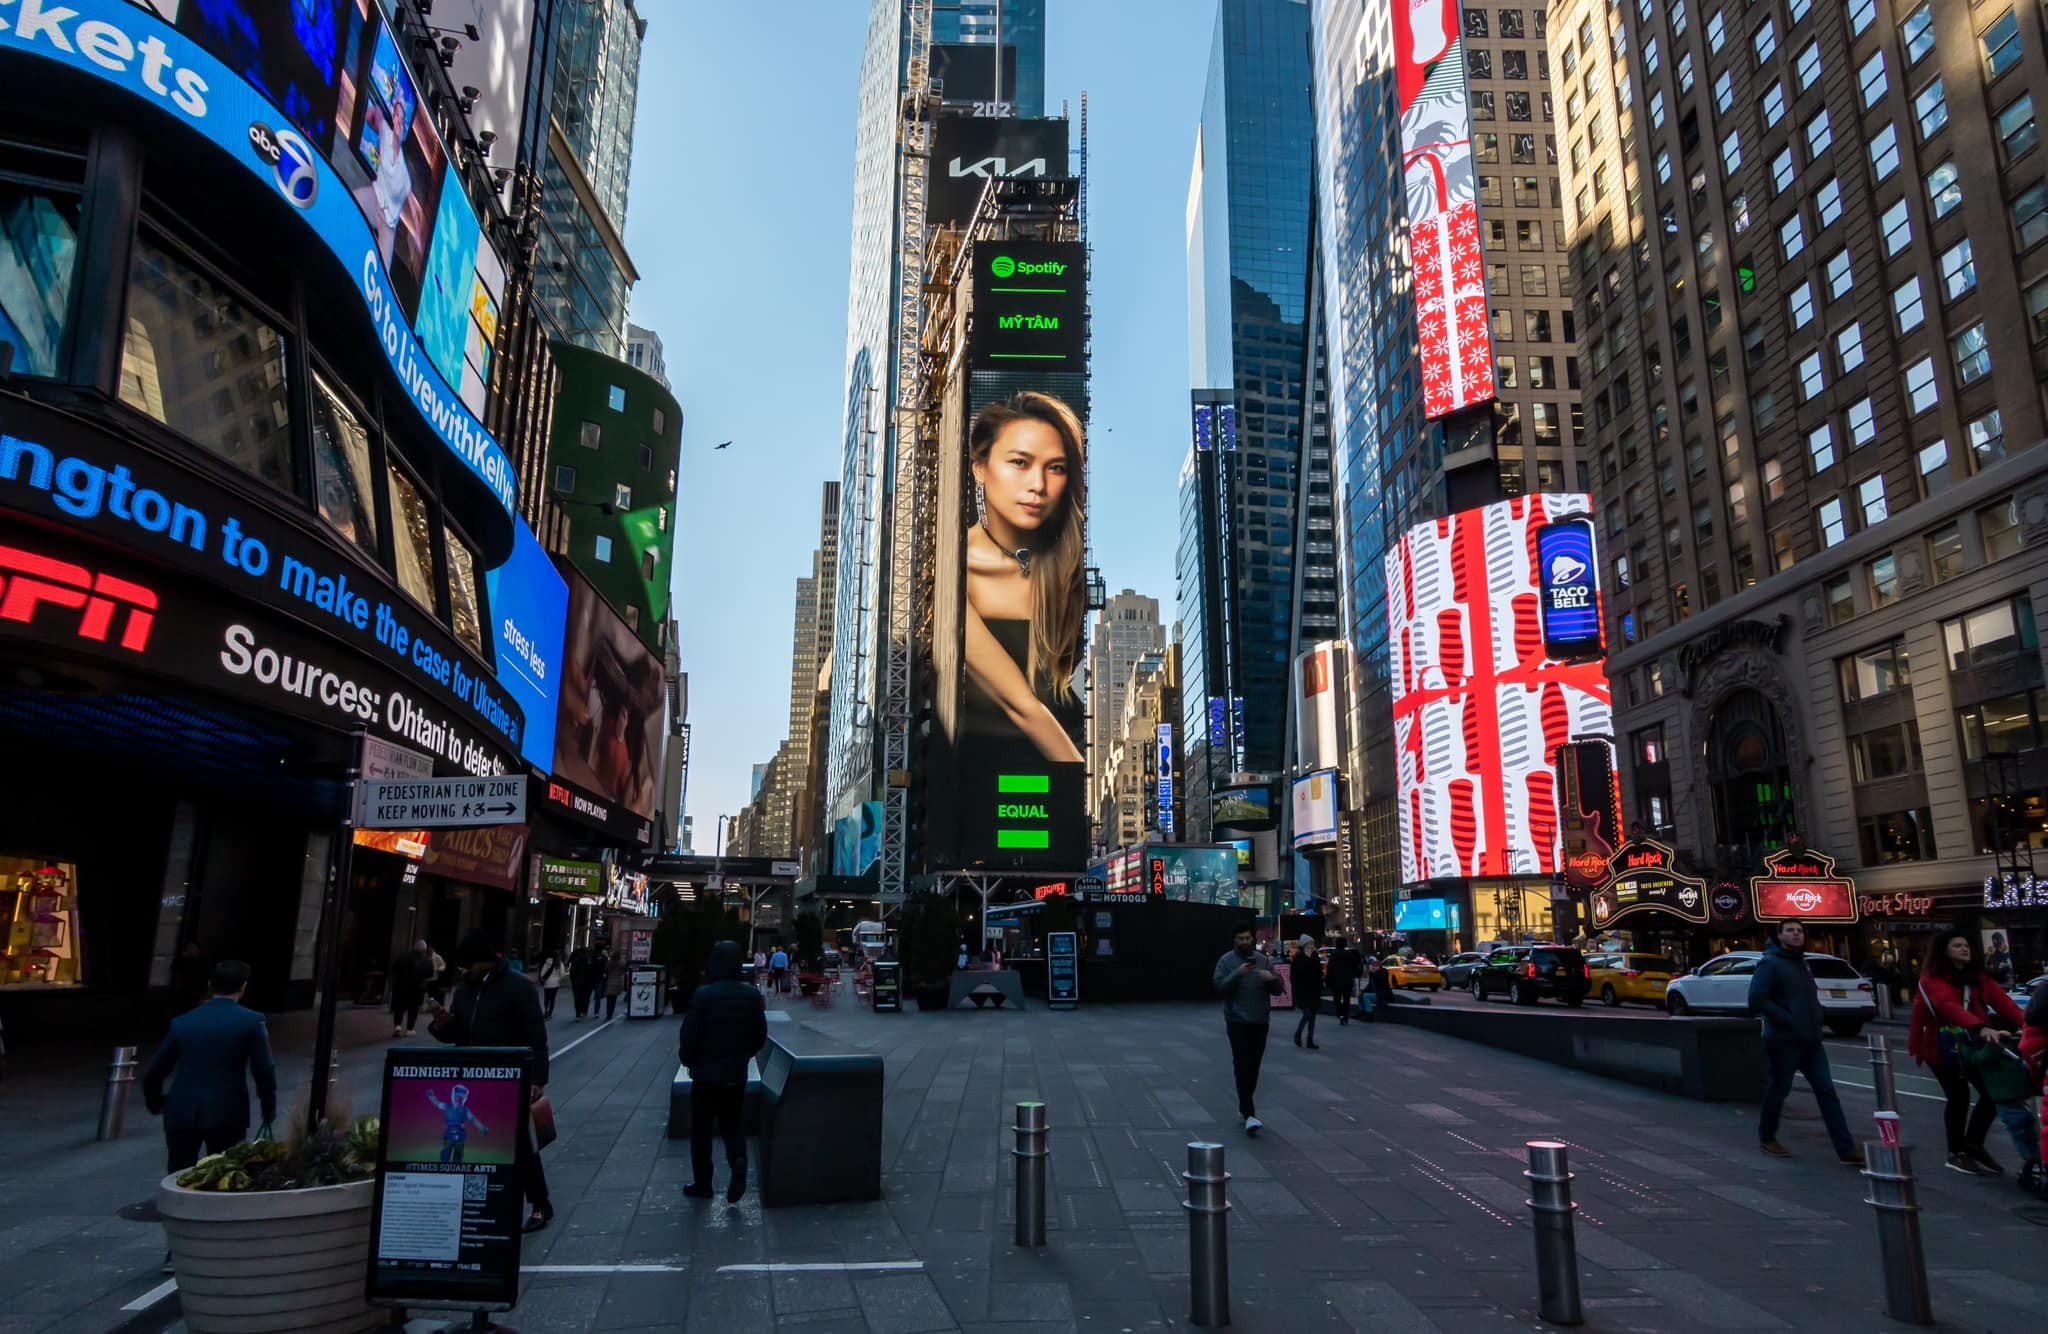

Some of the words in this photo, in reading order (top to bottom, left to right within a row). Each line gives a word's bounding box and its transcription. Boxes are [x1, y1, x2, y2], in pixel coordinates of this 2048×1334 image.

[0, 0, 208, 118] kets
[249, 127, 280, 160] abc
[1018, 262, 1067, 276] Spotify
[363, 250, 383, 323] Go
[383, 302, 398, 357] to
[1025, 315, 1058, 329] TÂM
[1550, 586, 1588, 598] TACO
[1553, 596, 1590, 609] BELL
[222, 517, 268, 577] to
[280, 555, 369, 630] make
[376, 601, 409, 655] the
[413, 638, 451, 685] case
[452, 660, 473, 702] for
[473, 677, 510, 737] Ukraine
[503, 618, 530, 662] stress
[529, 640, 546, 680] less
[220, 623, 382, 723] Sources:
[387, 691, 447, 755] Ohtani
[448, 727, 463, 764] to
[464, 739, 493, 777] defer
[379, 784, 452, 801] PEDESTRIAN
[455, 783, 486, 799] FLOW
[489, 782, 520, 797] ZONE
[548, 781, 571, 808] NETFLIX
[574, 796, 587, 812] NOW
[587, 802, 608, 822] PLAYING
[378, 805, 407, 820] KEEP
[412, 803, 456, 819] MOVING
[998, 804, 1049, 818] EQUAL
[1341, 819, 1353, 869] SQUARE
[1570, 858, 1589, 867] Hard
[1628, 853, 1645, 867] Hard
[1645, 851, 1663, 868] Rock
[406, 863, 419, 874] NOW
[1775, 863, 1797, 873] Hard
[1798, 863, 1820, 876] Rock
[402, 873, 417, 885] OPEN
[547, 875, 587, 886] COFFEE
[1153, 860, 1164, 895] BAR
[1103, 893, 1148, 903] HOTDOGS
[1785, 893, 1804, 902] Hard
[1804, 893, 1822, 903] Rock
[1858, 895, 1895, 916] Rock
[1893, 892, 1932, 915] Shop
[393, 1066, 460, 1078] MIDNIGHT
[439, 1164, 472, 1172] SQUARE
[474, 1165, 497, 1173] ARTS
